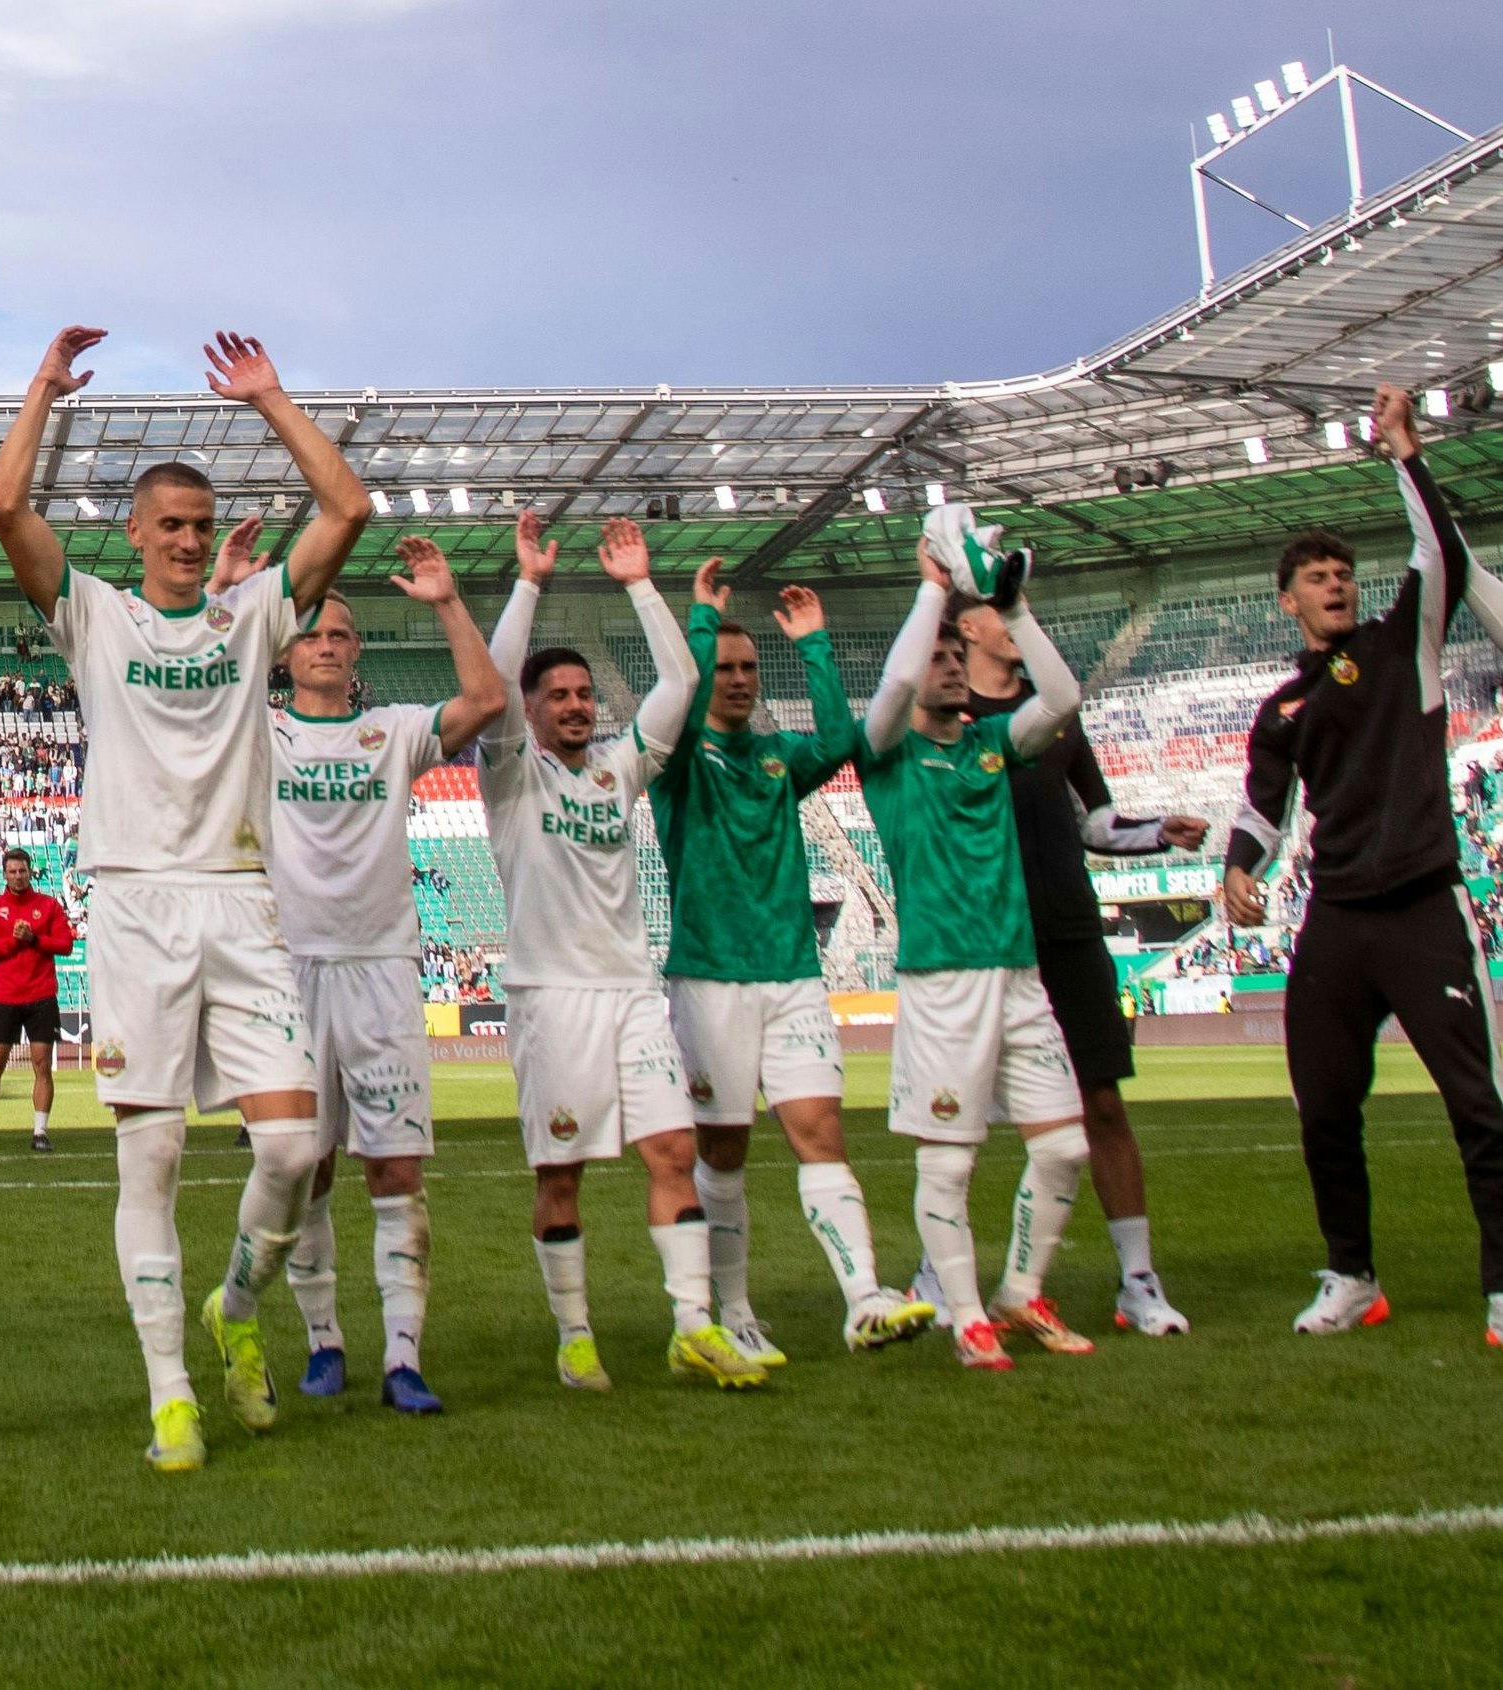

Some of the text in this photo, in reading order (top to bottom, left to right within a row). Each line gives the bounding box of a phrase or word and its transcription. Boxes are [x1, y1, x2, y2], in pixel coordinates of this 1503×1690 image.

[126, 660, 240, 690] ENERGIE
[293, 762, 372, 780] WIEN
[278, 780, 387, 802] ENERGIE
[560, 794, 621, 822] WIEN
[453, 1042, 509, 1058] Vorteil
